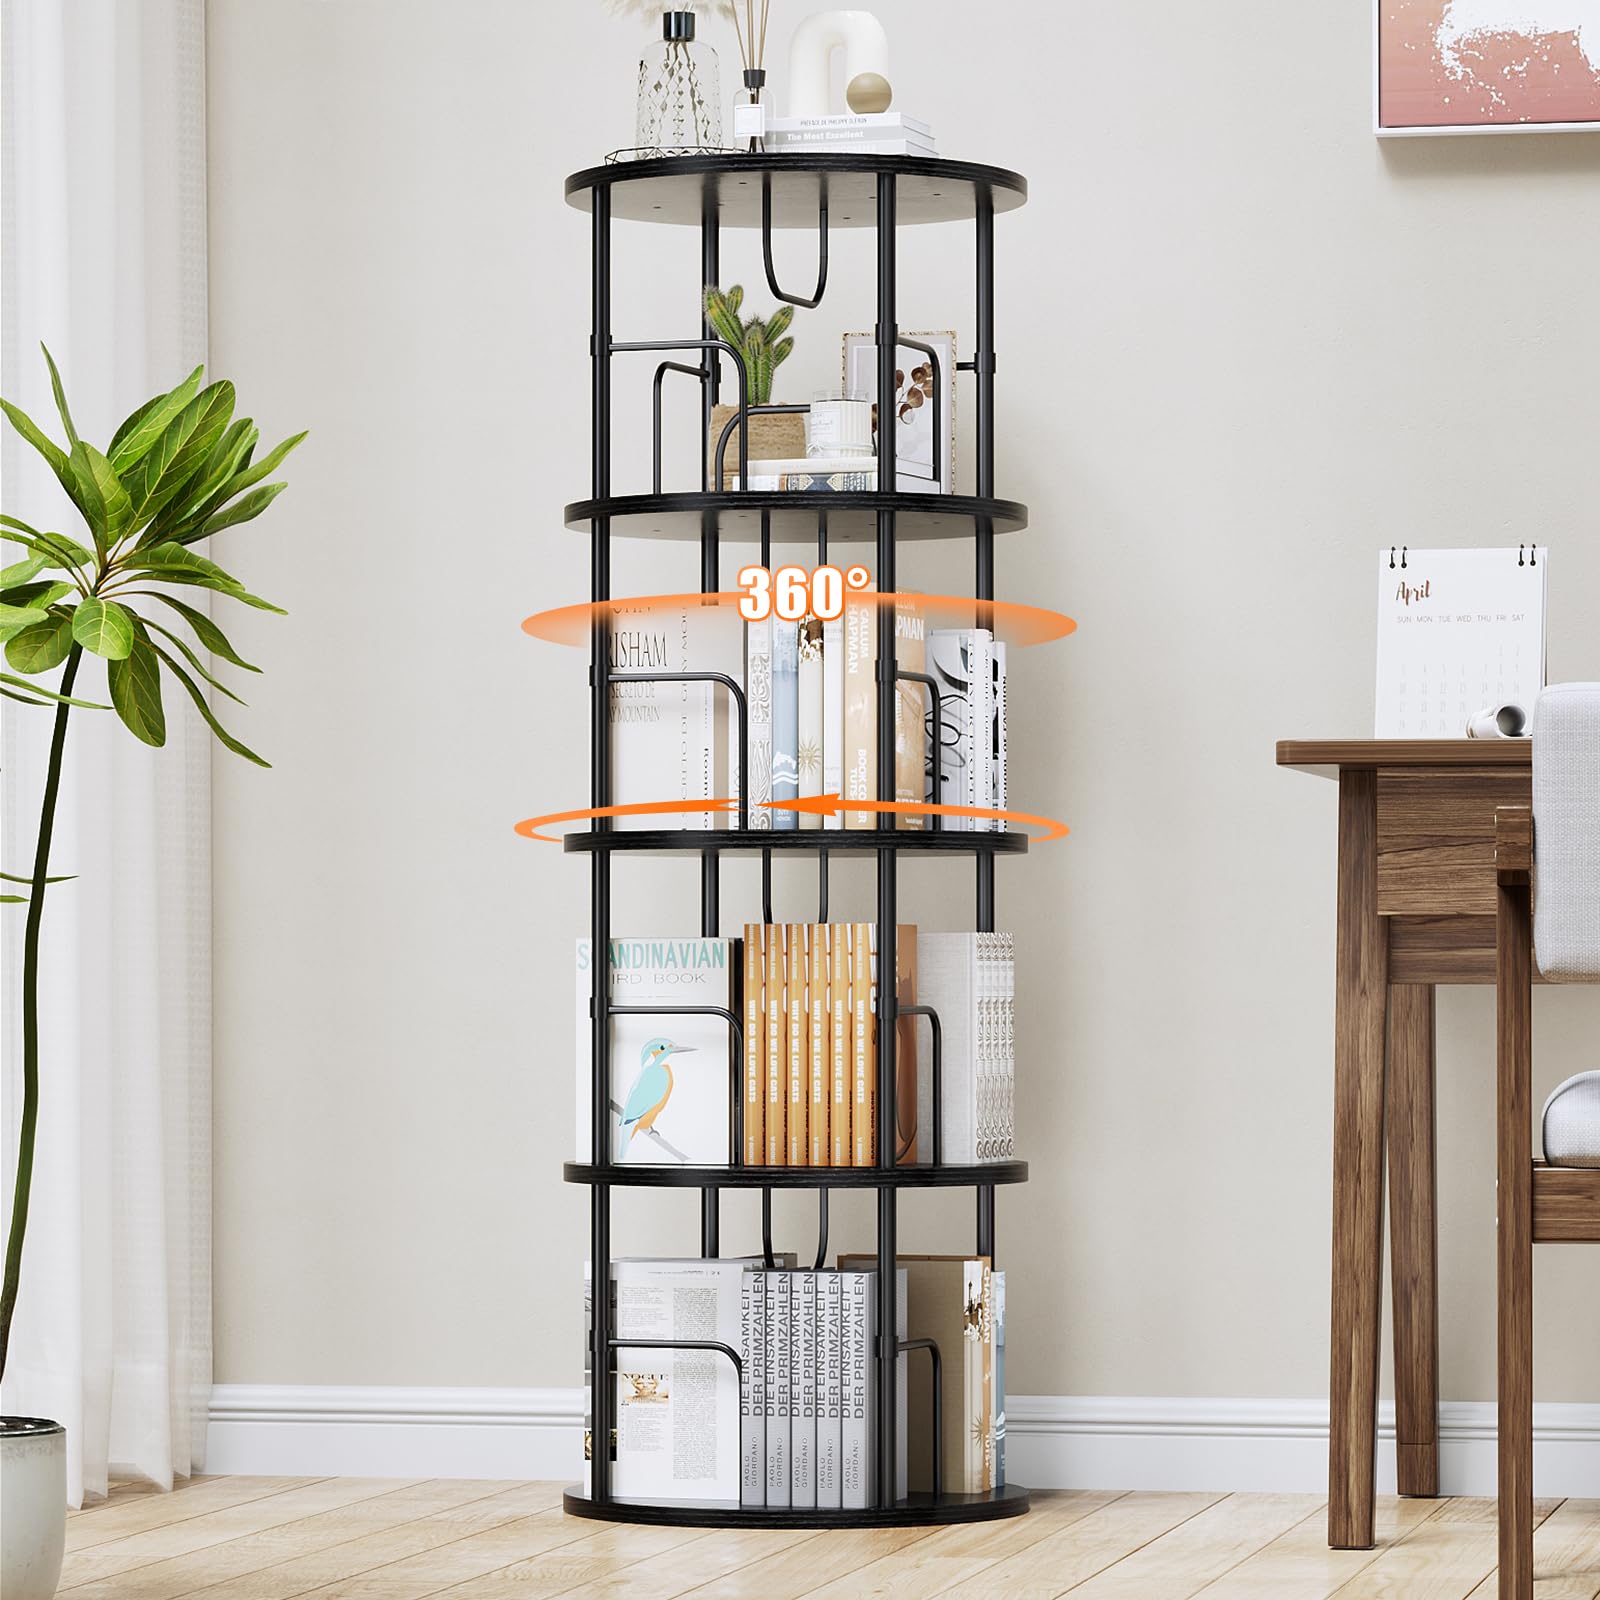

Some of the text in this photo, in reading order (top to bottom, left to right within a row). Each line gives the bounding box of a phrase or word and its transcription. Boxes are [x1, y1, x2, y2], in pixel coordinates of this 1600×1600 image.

[787, 130, 864, 141] The Most Excellent
[860, 608, 869, 659] CALLUM
[1396, 579, 1431, 606] April
[1456, 615, 1472, 623] WED
[1477, 615, 1492, 623] THU
[1496, 614, 1507, 622] FRI
[1512, 614, 1525, 622] SAT
[858, 749, 867, 823] BOOK COER
[577, 941, 725, 970] SANDINAVIAN
[612, 973, 707, 985] IRD BOOK
[623, 1373, 669, 1381] VOGUE
[742, 1289, 750, 1416] DIE EINSAMKEIT
[753, 1273, 762, 1416] DER PRIMZAHLEN
[766, 1289, 774, 1416] DIE EINSAMKEIT
[778, 1273, 788, 1416] DER PRIMZAHLEN
[792, 1290, 800, 1417] DIE EINSAMKEIT
[804, 1274, 814, 1418] DER PRIMZAHLEN
[817, 1290, 825, 1418] DIE EINSAMKEIT
[829, 1274, 838, 1418] DER PRIMZAHLEN
[842, 1290, 850, 1418] DIE EINSAMKEIT
[854, 1274, 864, 1418] DER PRIMZAHLEN
